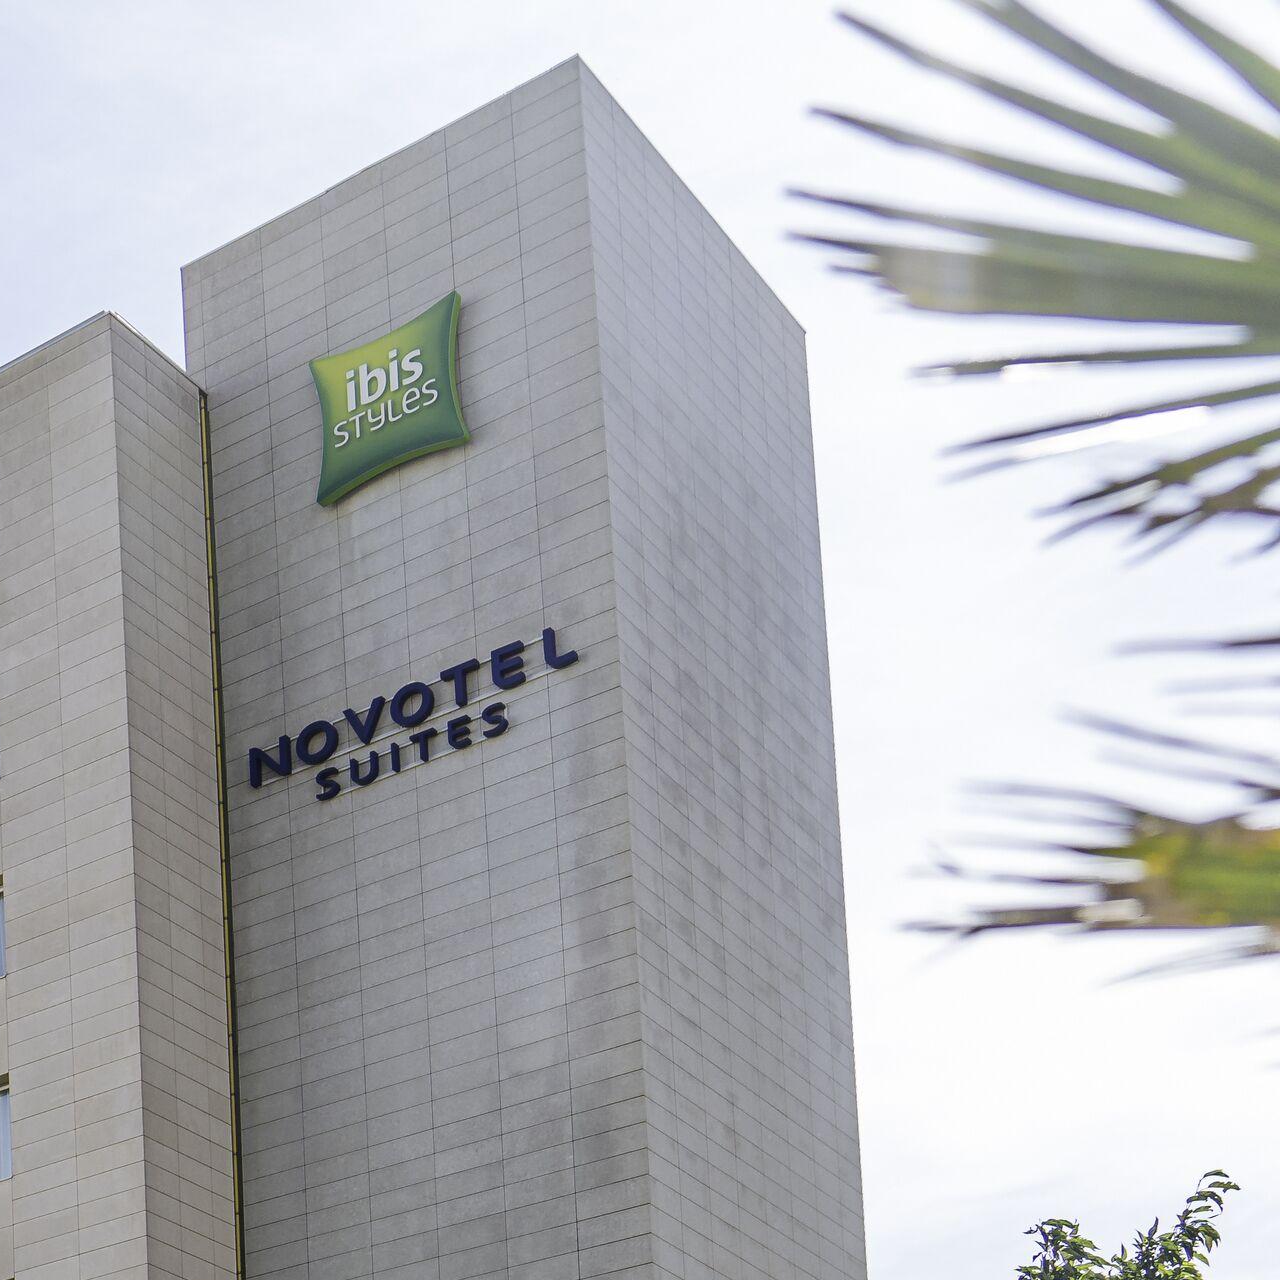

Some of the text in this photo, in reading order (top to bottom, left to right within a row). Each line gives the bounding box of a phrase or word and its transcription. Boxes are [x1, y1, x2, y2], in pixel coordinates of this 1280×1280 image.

[345, 345, 423, 413] ibis
[248, 627, 579, 788] NOVOTEL
[315, 701, 509, 800] SUITES
